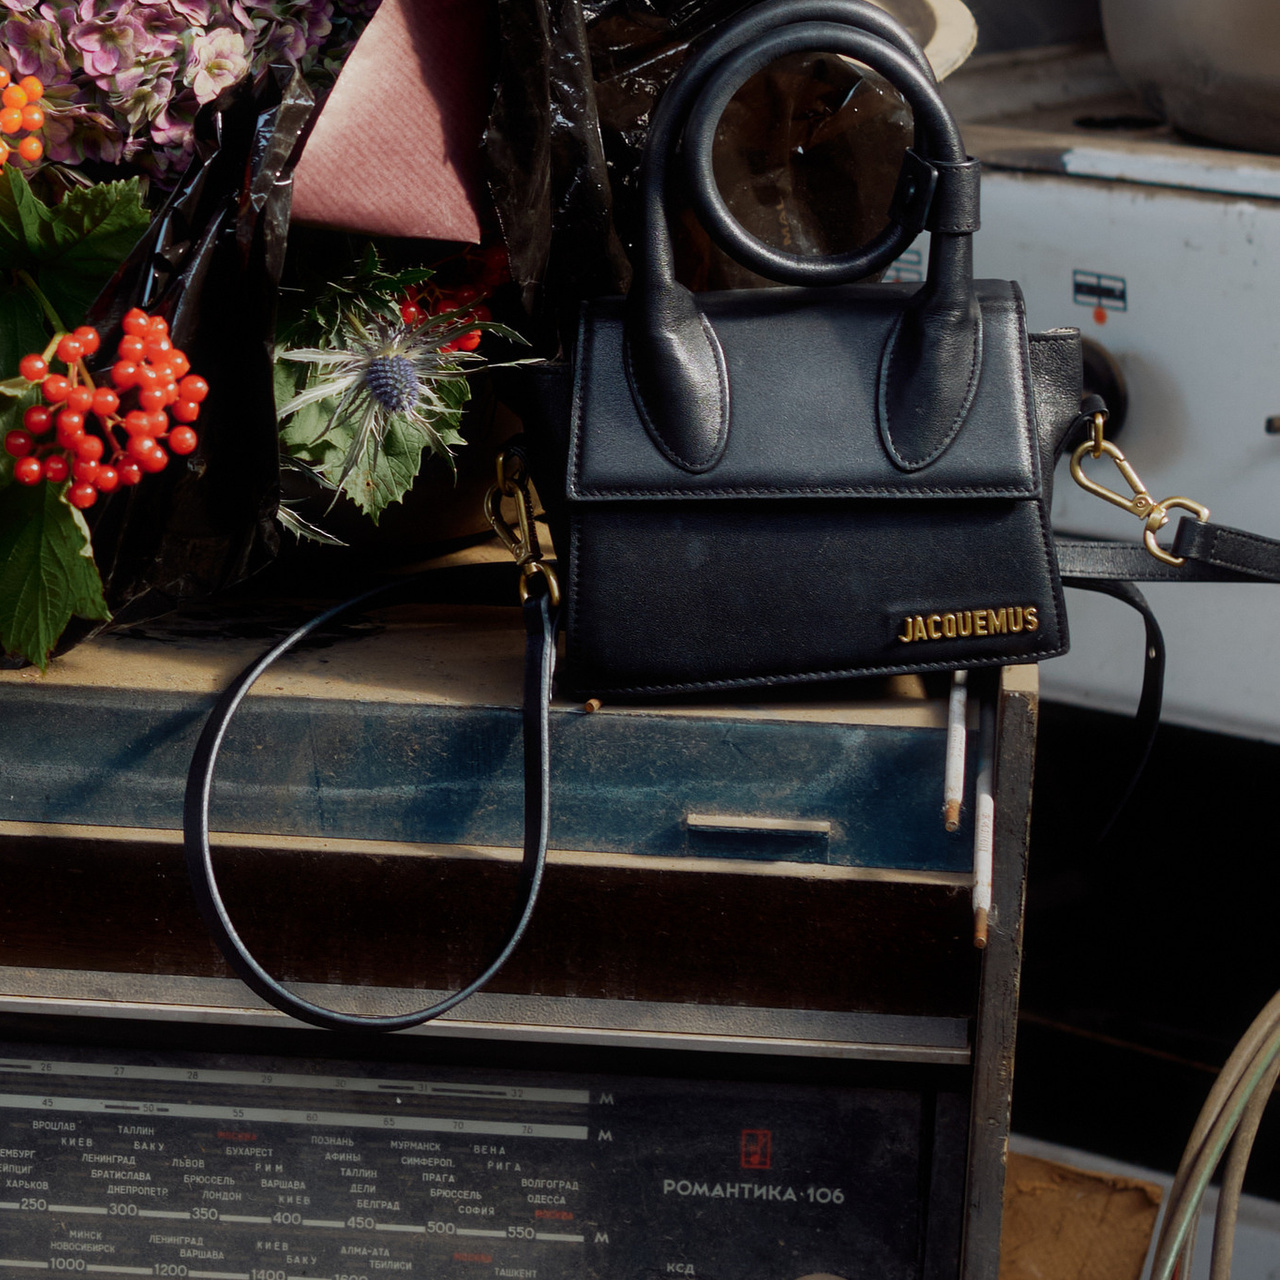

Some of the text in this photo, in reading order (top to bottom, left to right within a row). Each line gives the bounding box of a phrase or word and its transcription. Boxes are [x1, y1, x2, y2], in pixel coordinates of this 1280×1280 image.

[898, 605, 1039, 644] JACQUEMUS
[40, 1062, 52, 1071] 26
[113, 1066, 125, 1075] 27
[187, 1071, 199, 1080] 28
[261, 1074, 273, 1083] 29
[418, 1083, 428, 1092] 31
[511, 1089, 524, 1098] 32
[599, 1092, 614, 1105] М
[32, 1120, 76, 1131] ВРОЦЛАВ
[118, 1125, 155, 1135] ТАЛЛИН
[311, 1135, 354, 1147] ПОЗНАНЬ
[390, 1140, 441, 1151] МУРМАНСК
[473, 1145, 506, 1155] ВЕНА
[42, 1098, 53, 1107] 45
[142, 1103, 155, 1113] 50
[232, 1108, 244, 1118] 55
[306, 1112, 318, 1121] 60
[384, 1117, 395, 1126] 65
[453, 1121, 464, 1130] 70
[598, 1129, 613, 1142] М
[61, 1137, 93, 1147] КИЕВ
[133, 1141, 164, 1151] БАКУ
[225, 1146, 273, 1156] БУХАРЕСТ
[325, 1152, 361, 1162] АФИНЫ
[400, 1156, 456, 1168] СИМФЕРОП.
[487, 1160, 521, 1171] РИГА
[82, 1153, 136, 1165] ЛЕНИНГРАД
[172, 1158, 205, 1168] ЛЬВОВ
[255, 1163, 283, 1173] РИМ
[340, 1167, 378, 1178] ТАЛЛИН
[422, 1172, 455, 1183] ПРАГА
[521, 1178, 579, 1190] ВОЛГОГРАД
[5, 1179, 49, 1190] ХАРЬКОВ
[202, 1190, 242, 1201] ЛОНДОН
[278, 1195, 311, 1205] КИЕВ
[356, 1199, 400, 1211] БЕЛГРАД
[458, 1205, 495, 1215] СОФИЯ
[90, 1170, 151, 1181] БРАТИСЛАВА
[183, 1174, 236, 1186] БРЮССЕЛЬ
[261, 1178, 306, 1190] ВАРШАВА
[349, 1183, 376, 1194] ДЕЛИ
[430, 1188, 482, 1200] БРЮССЕЛЬ
[527, 1194, 566, 1205] ОДЕССА
[663, 1179, 845, 1205] РОМАНТИКА 106
[21, 1198, 47, 1211] 250
[109, 1203, 138, 1216] 300
[192, 1207, 218, 1220] 350
[273, 1212, 302, 1224] 400
[347, 1216, 375, 1229] 450
[427, 1221, 455, 1234] 500
[508, 1226, 535, 1239] 550
[594, 1231, 609, 1244] М
[50, 1241, 537, 1278] НОВОСИБИРСК ВАРШАВА БАКУ ТБИЛИСИ ТАШКЕНТ
[69, 1229, 102, 1240] МИНСК
[148, 1234, 204, 1246] ЛЕНИНГРАД
[256, 1241, 289, 1251] КИЕВ
[340, 1246, 390, 1257] АЛМА-АТА
[50, 1257, 85, 1271] 1000
[154, 1263, 188, 1277] 1200
[666, 1262, 695, 1275] КСД
